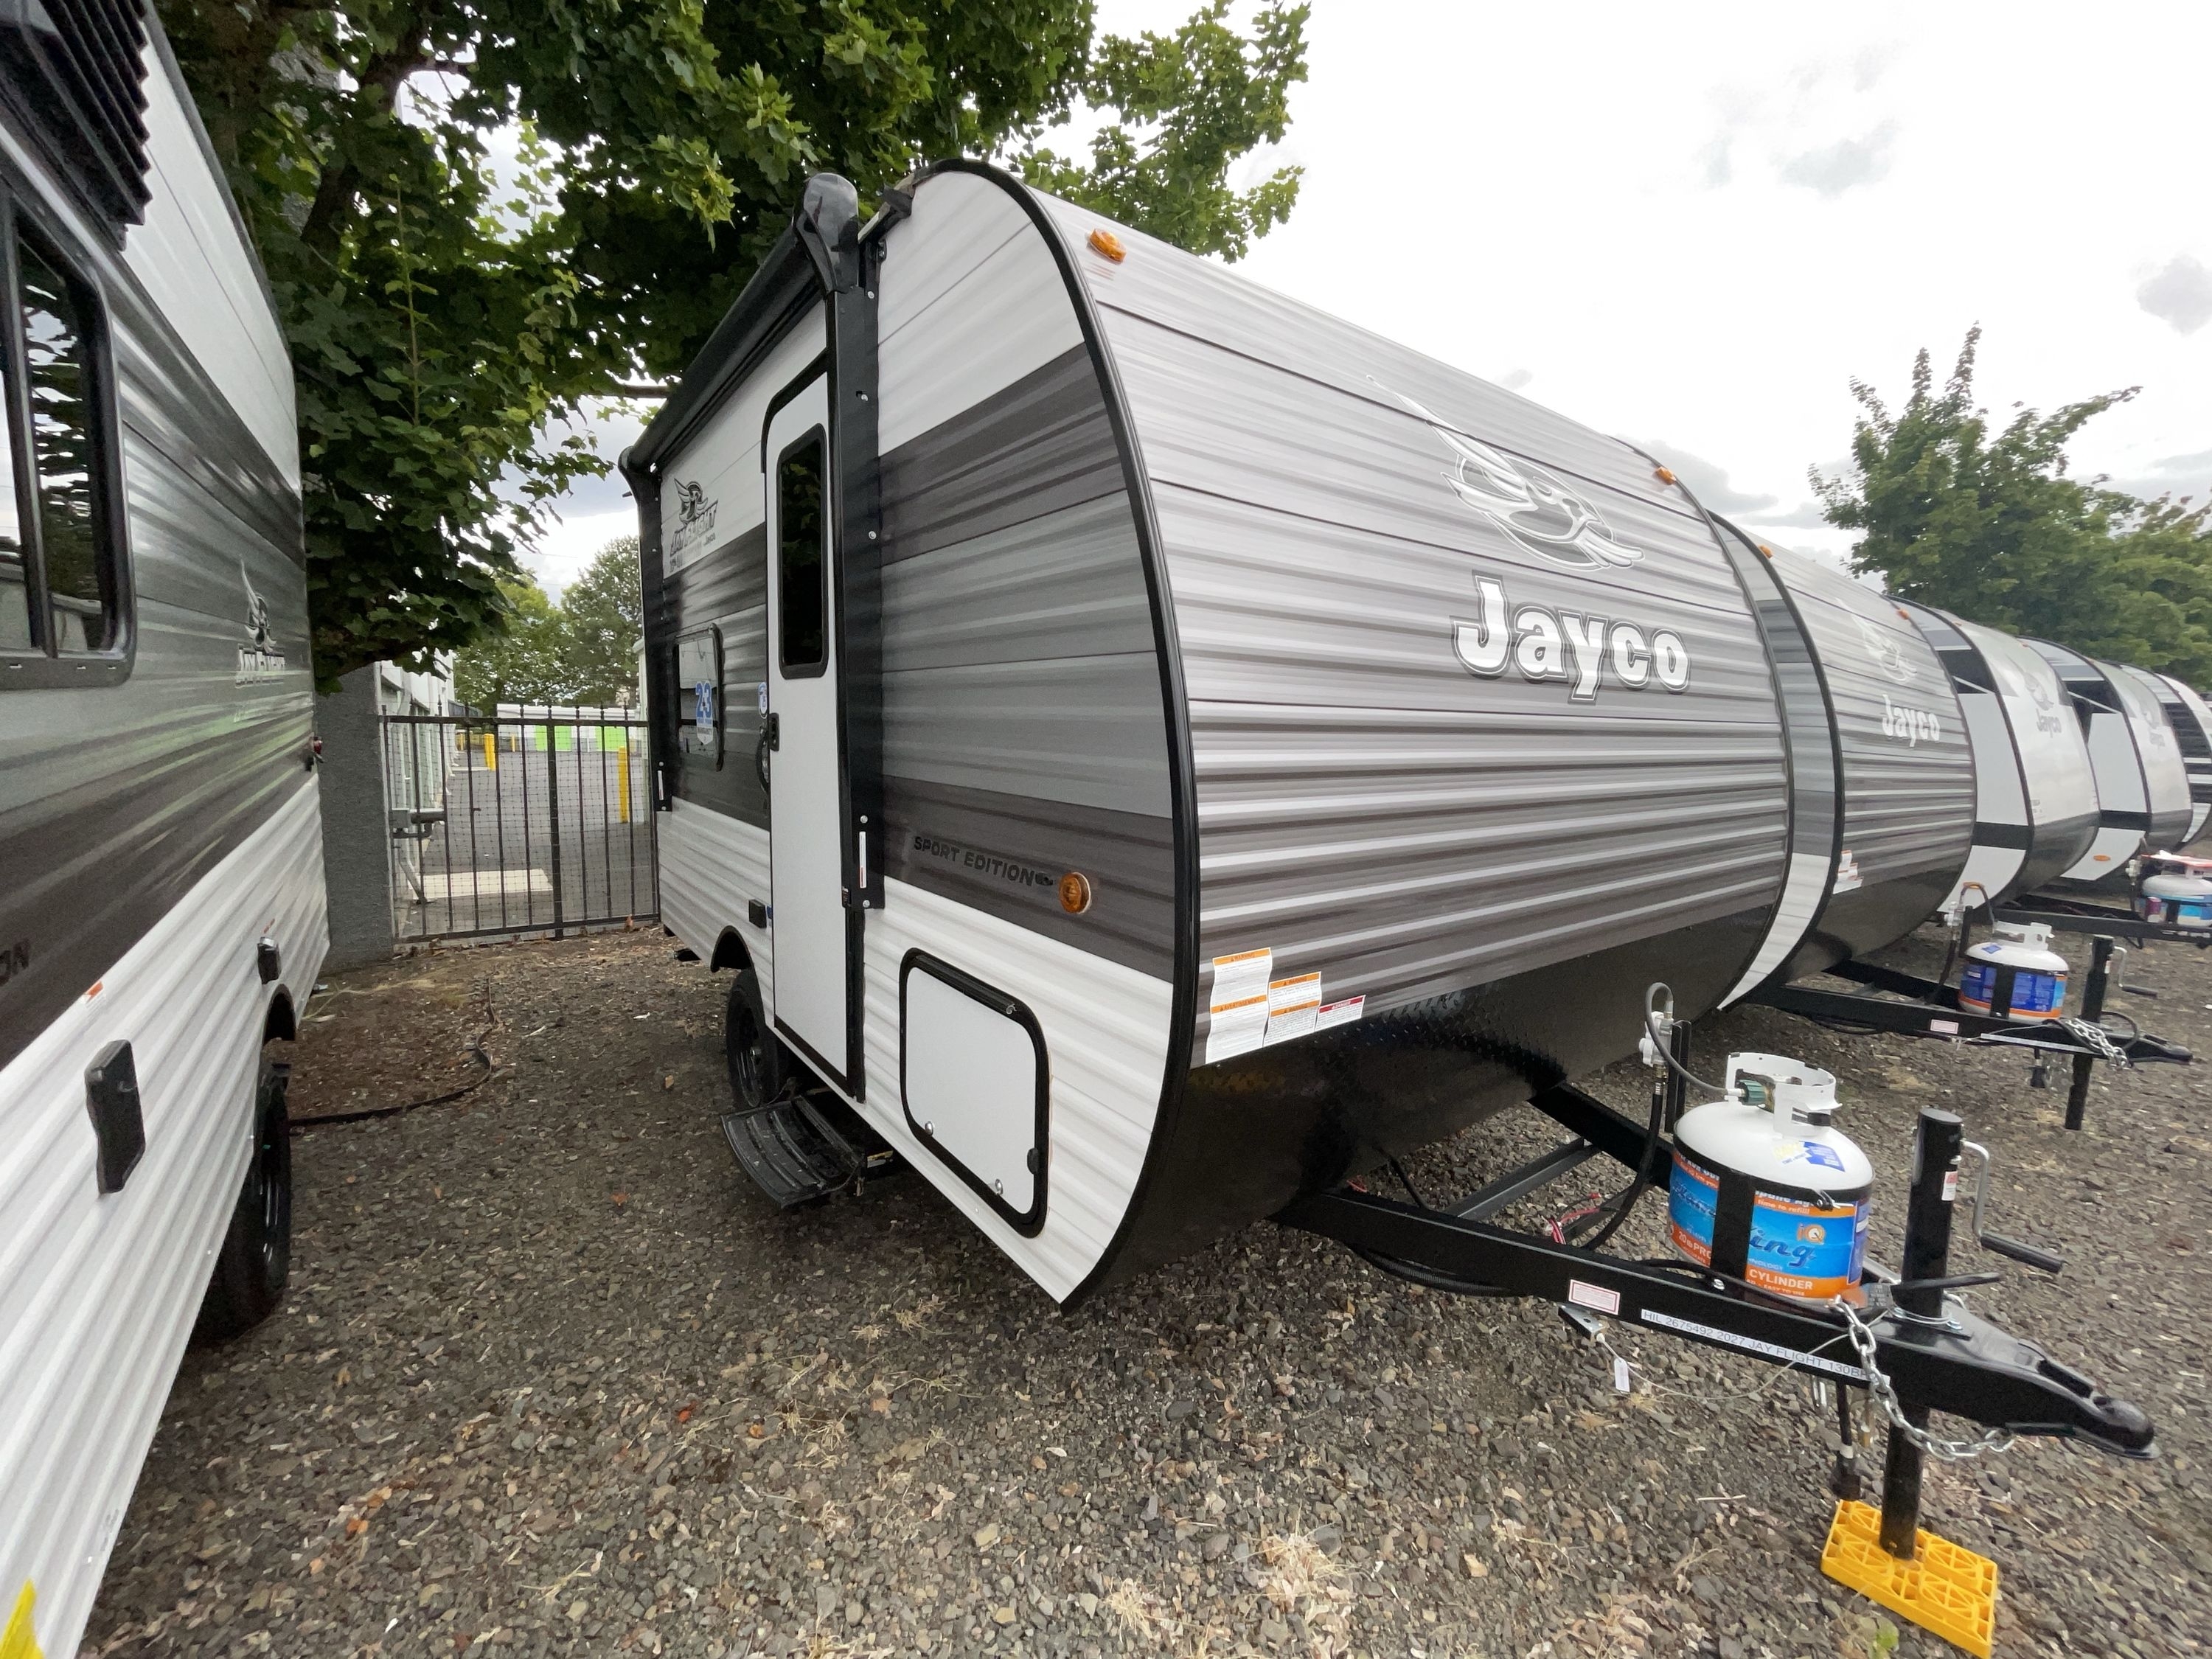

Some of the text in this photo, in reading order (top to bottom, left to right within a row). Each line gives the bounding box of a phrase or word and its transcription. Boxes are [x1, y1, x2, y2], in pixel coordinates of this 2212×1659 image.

[1452, 572, 1691, 703] Jayco
[1882, 694, 1940, 747] Jayco
[914, 836, 1035, 886] SPORT EDITION
[1750, 1225, 1816, 1269] ing
[1749, 1268, 1813, 1290] CYLINDER
[1643, 1311, 1661, 1323] HIL
[1665, 1317, 1714, 1338] 2675492
[1716, 1331, 1745, 1345] 2027
[1748, 1340, 1773, 1353] JAY
[1775, 1347, 1823, 1367] FLIGHT
